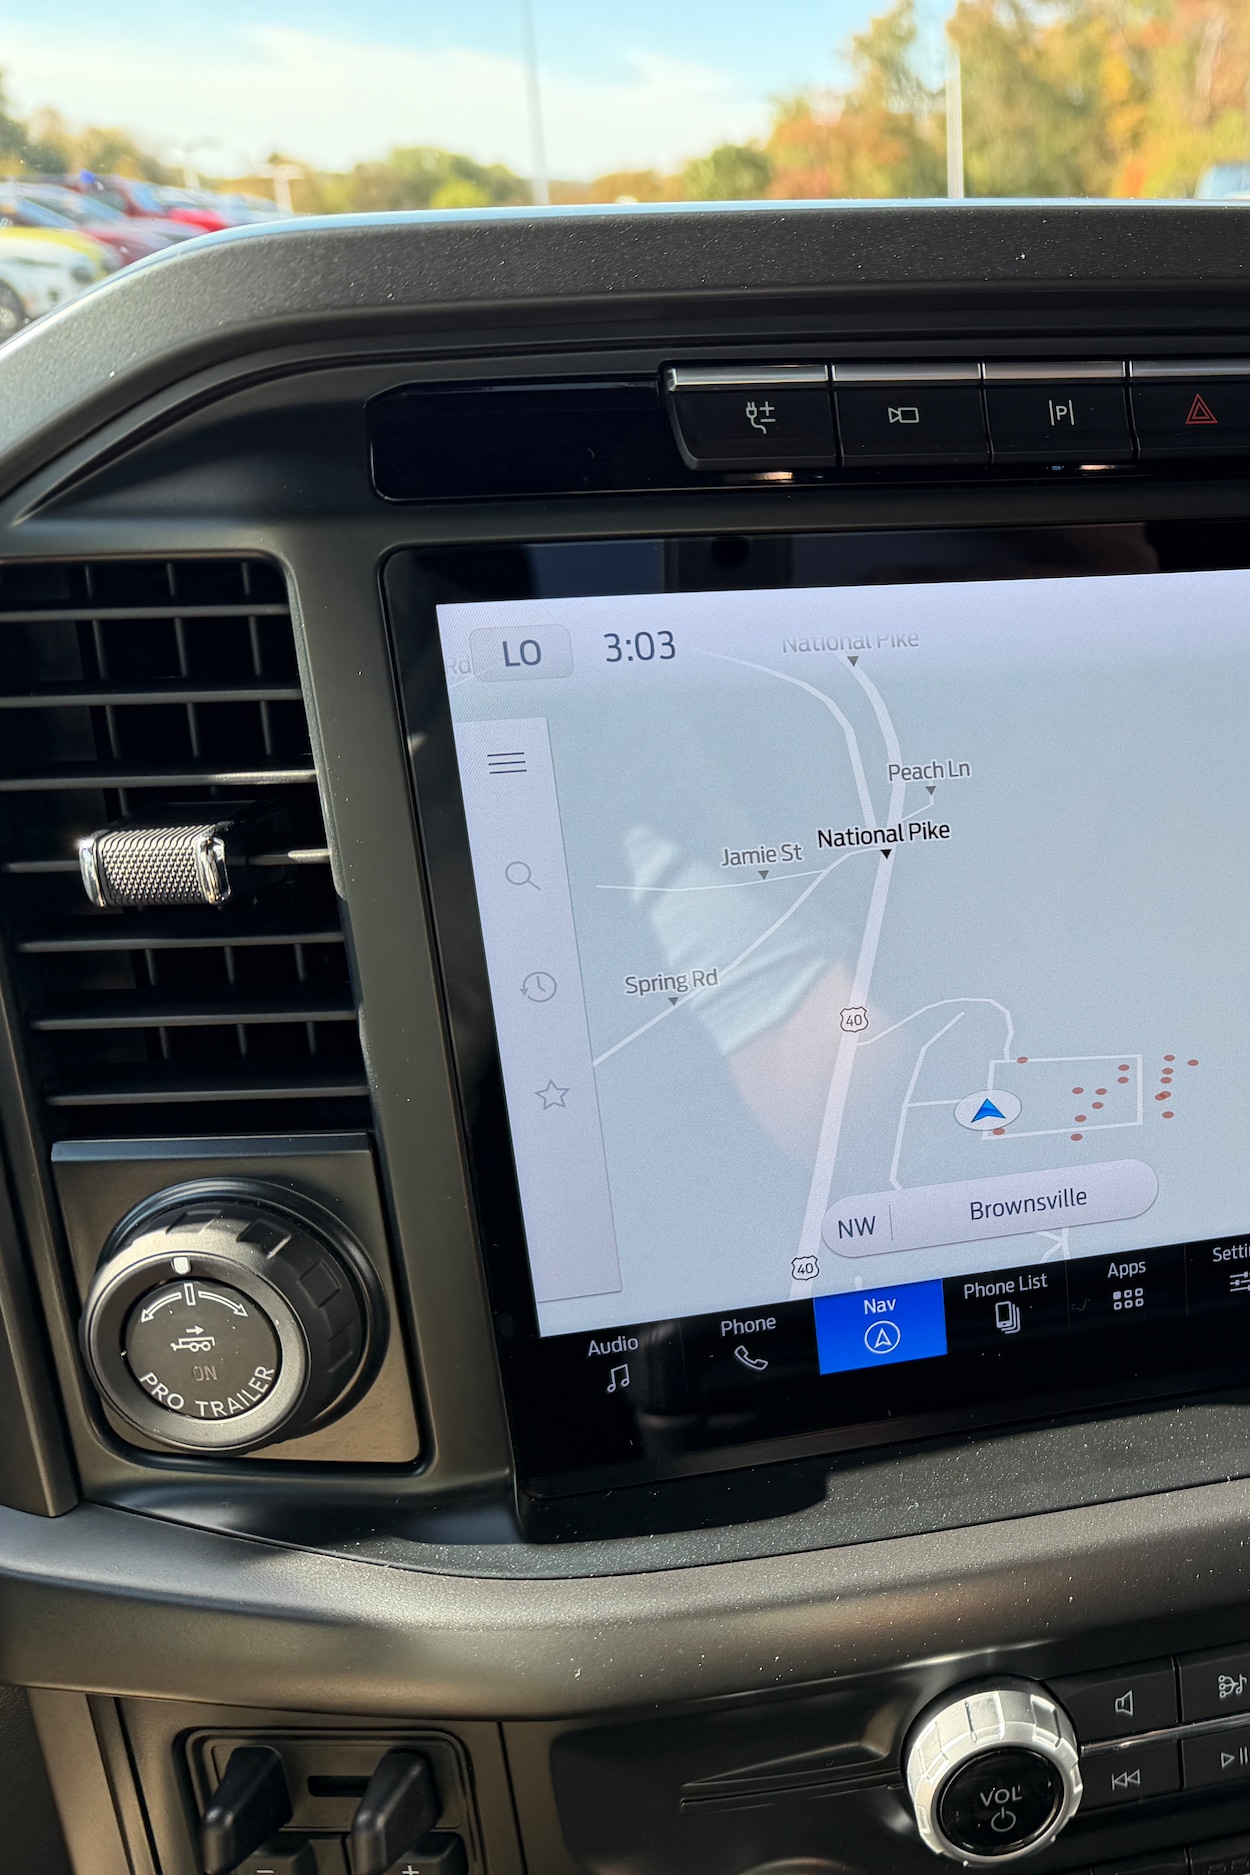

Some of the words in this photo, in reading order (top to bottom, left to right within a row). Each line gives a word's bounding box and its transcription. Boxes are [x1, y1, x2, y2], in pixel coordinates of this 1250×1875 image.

[502, 639, 542, 668] LO
[602, 629, 678, 663] 3:03
[782, 632, 872, 653] National
[876, 630, 920, 650] Pike
[888, 762, 943, 783] Peach
[948, 760, 972, 779] Ln
[817, 823, 904, 849] National
[908, 821, 951, 842] Pike
[721, 845, 777, 869] Jamie
[781, 843, 804, 862] St
[625, 972, 688, 997] Spring
[692, 969, 718, 988] Rd
[845, 1013, 863, 1028] 40
[969, 1185, 1088, 1222] Brownsville
[837, 1215, 877, 1239] NW
[797, 1262, 814, 1276] 40
[1107, 1259, 1147, 1281] Apps
[963, 1279, 1015, 1300] Phone
[1018, 1273, 1049, 1294] List
[863, 1297, 897, 1315] Nav
[720, 1313, 777, 1337] Phone
[587, 1335, 640, 1358] Audio
[191, 1364, 218, 1382] ON
[139, 1372, 185, 1410] PRO
[195, 1365, 275, 1418] TRAILER
[979, 1788, 1023, 1808] VOL
